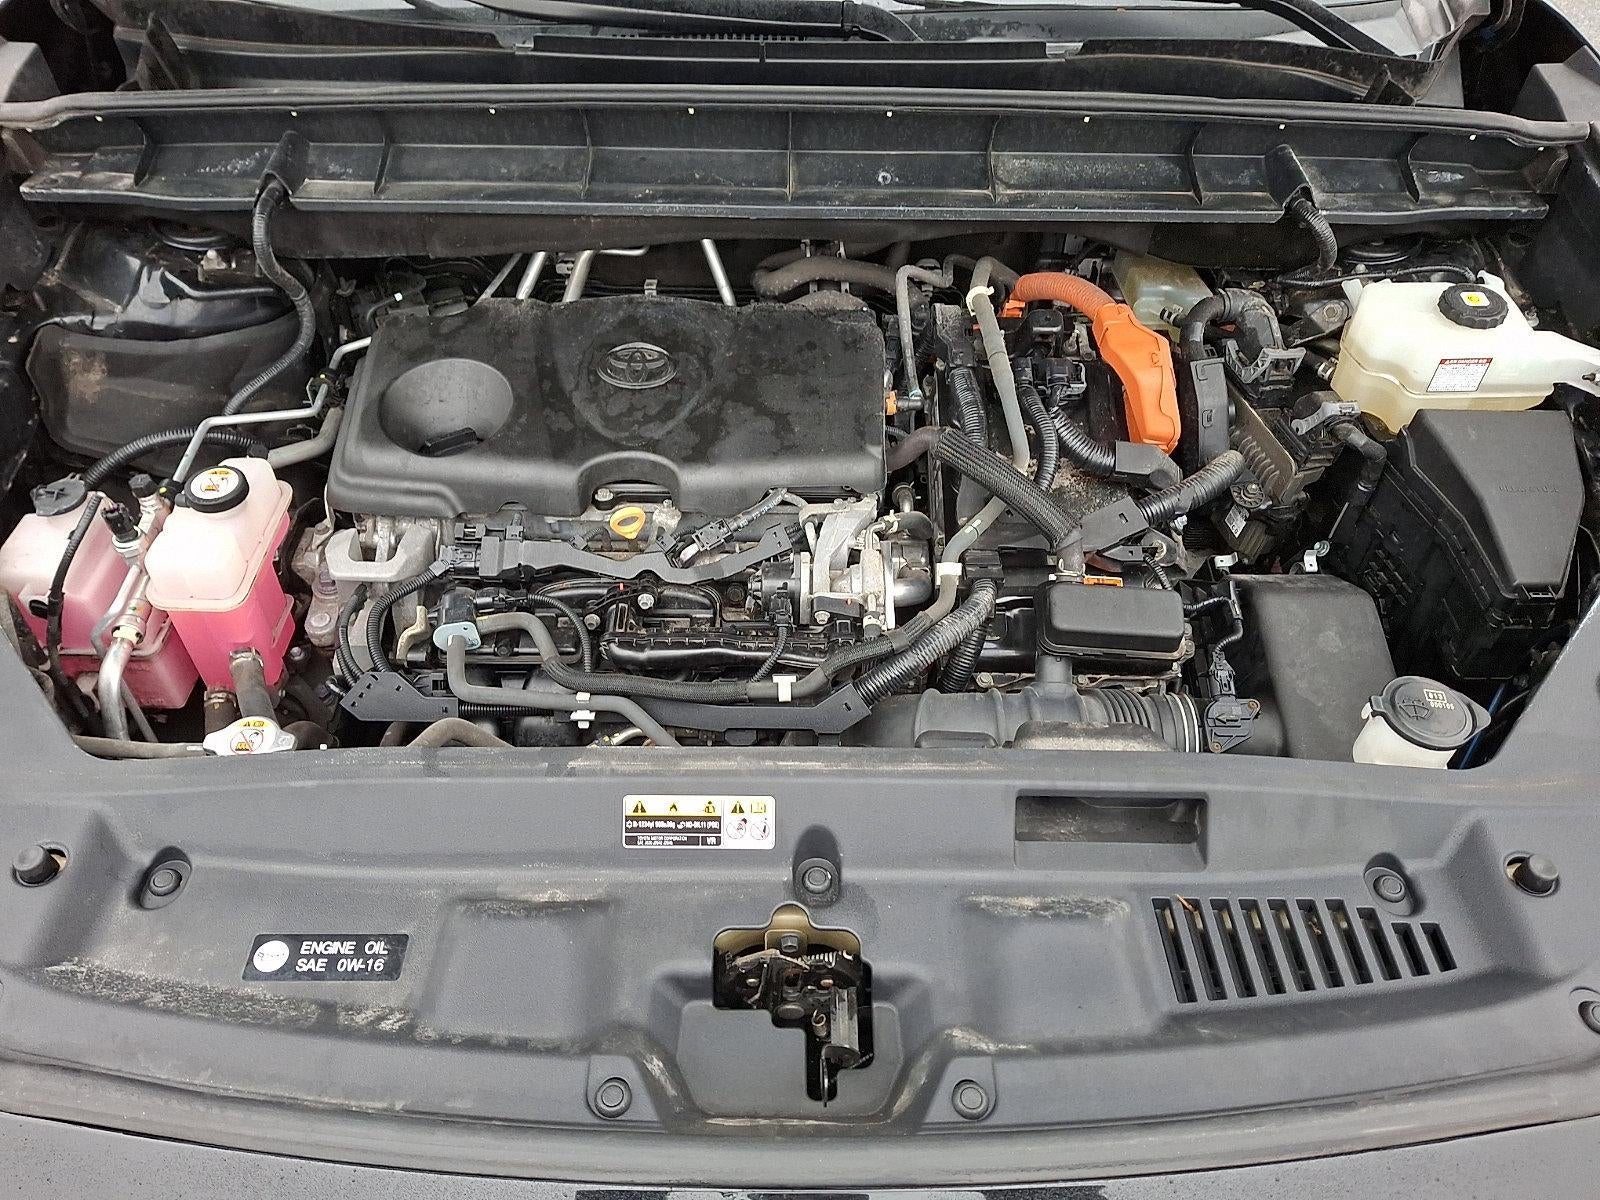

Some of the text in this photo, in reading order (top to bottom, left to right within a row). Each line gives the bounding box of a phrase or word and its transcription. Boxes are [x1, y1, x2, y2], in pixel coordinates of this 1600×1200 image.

[300, 941, 389, 955] ENGINE OIL
[295, 958, 385, 972] SAE 0W-16
